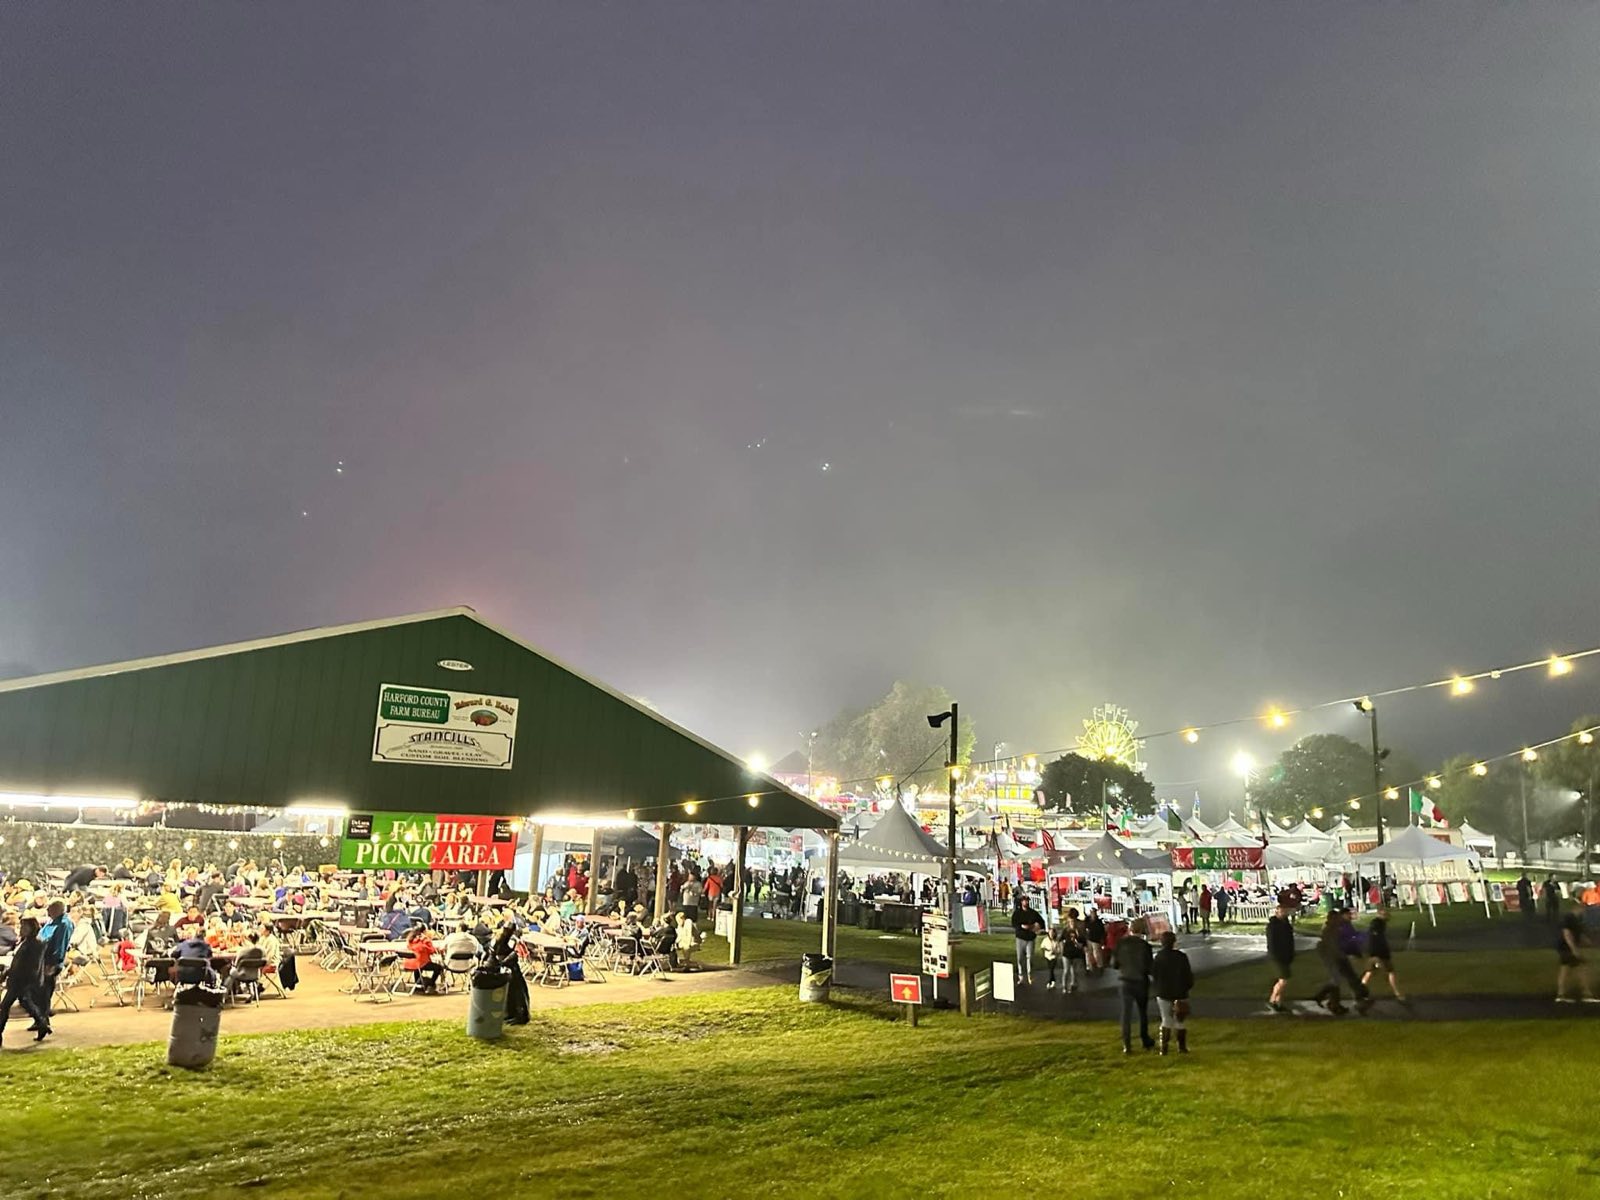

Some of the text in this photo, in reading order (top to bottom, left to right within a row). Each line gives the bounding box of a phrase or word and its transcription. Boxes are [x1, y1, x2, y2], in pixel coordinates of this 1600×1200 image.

[384, 692, 449, 708] HARFORD COUNTY
[390, 705, 411, 716] FARM
[412, 707, 440, 719] BUREAU
[391, 821, 479, 842] FAMILY
[355, 843, 500, 865] PICNIC AREA
